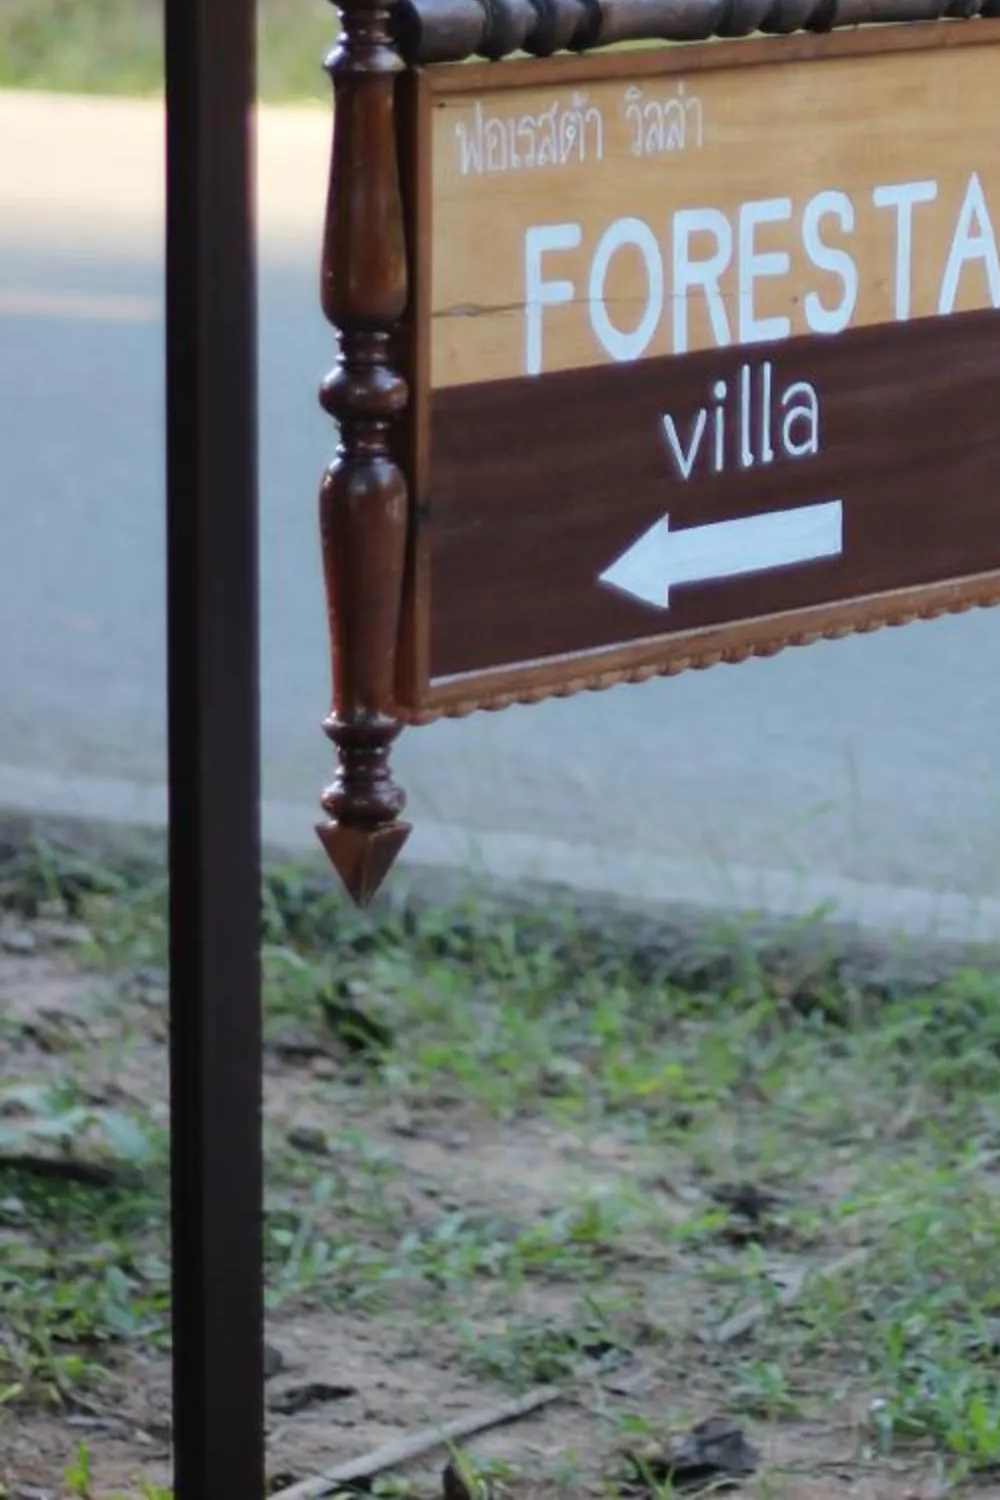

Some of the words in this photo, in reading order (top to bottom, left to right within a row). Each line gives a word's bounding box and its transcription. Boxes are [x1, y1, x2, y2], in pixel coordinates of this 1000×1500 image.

[624, 78, 703, 156] วิลล่า
[661, 361, 820, 479] villa
